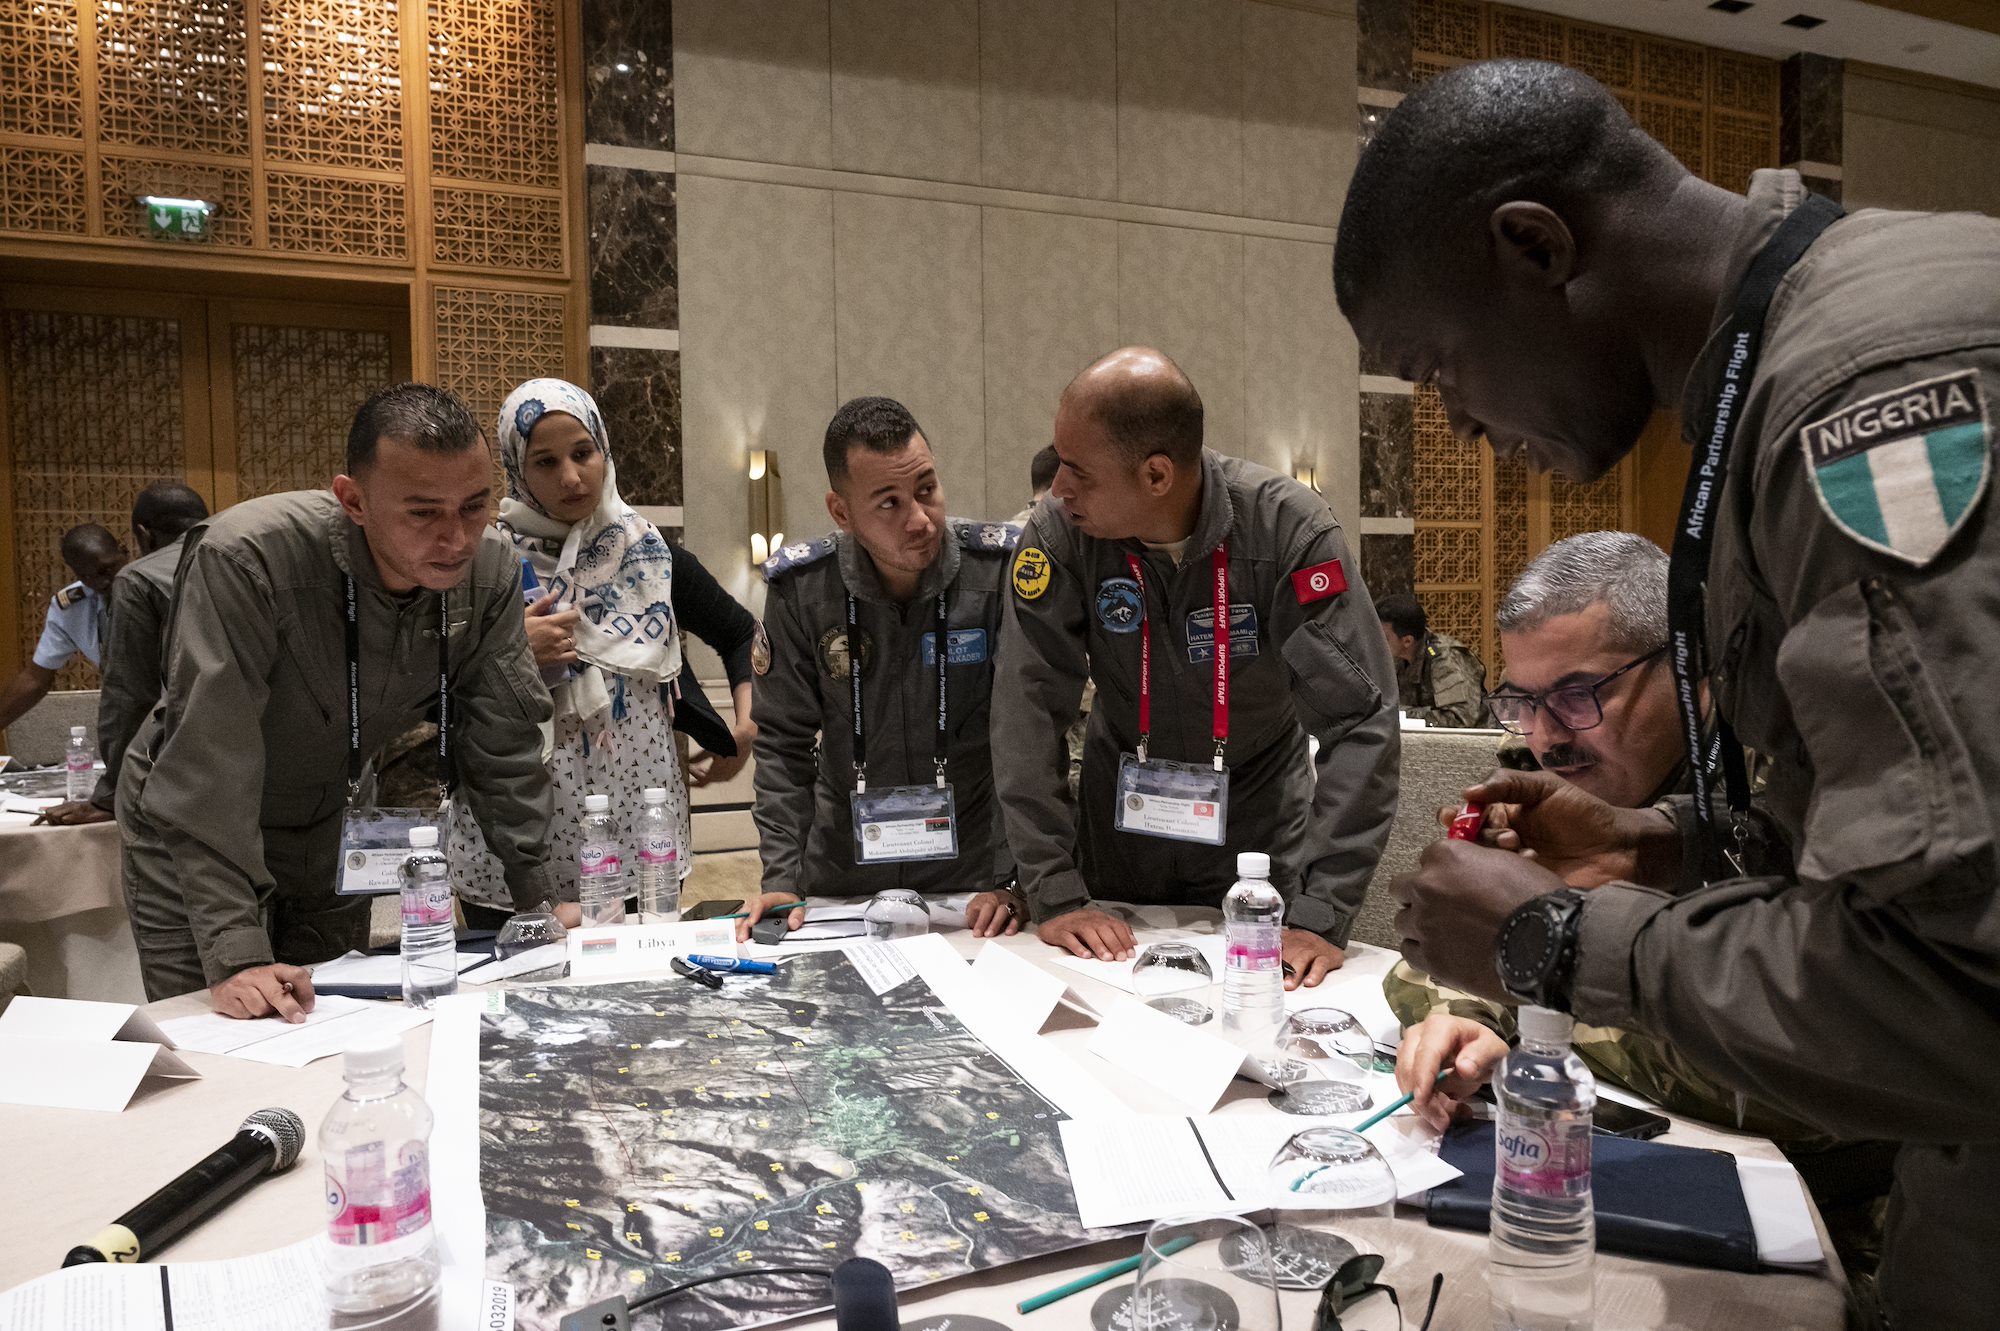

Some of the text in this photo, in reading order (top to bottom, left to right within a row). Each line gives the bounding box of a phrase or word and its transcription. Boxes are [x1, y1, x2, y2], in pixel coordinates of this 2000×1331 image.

[1686, 331, 1750, 540] African Partnership Flight
[1818, 383, 1974, 456] NIGERIA
[347, 601, 356, 622] Flight
[849, 602, 857, 625] African
[938, 601, 946, 620] Flight
[1217, 567, 1226, 629] SUPPORT STAFF
[1217, 643, 1226, 705] SUPPORT STAFF
[351, 687, 360, 727] Partnership
[853, 677, 861, 713] Partnership
[939, 677, 947, 712] Partnership
[854, 713, 862, 736] African
[938, 712, 947, 731] Flight
[1674, 630, 1708, 822] African Partnership Flight
[650, 839, 671, 849] Safia
[637, 937, 676, 950] Libya
[489, 1286, 507, 1331] 032019
